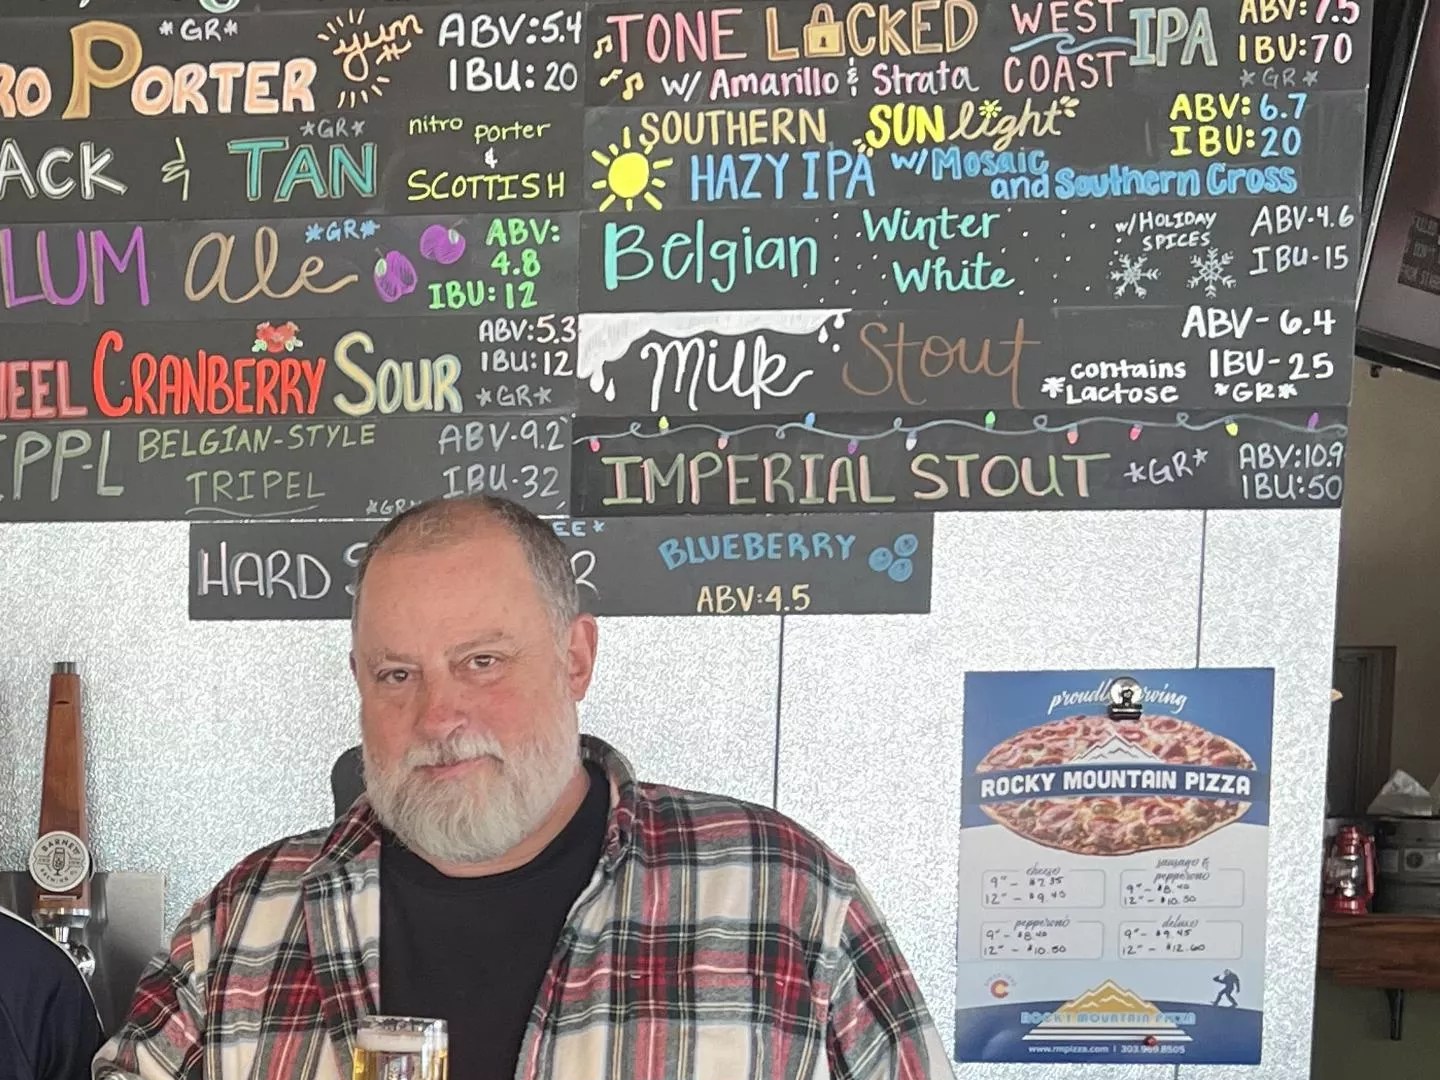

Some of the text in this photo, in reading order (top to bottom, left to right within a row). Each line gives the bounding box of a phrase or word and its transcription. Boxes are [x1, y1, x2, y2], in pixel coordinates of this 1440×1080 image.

[606, 8, 747, 63] TONE
[1127, 6, 1218, 67] IPA
[1010, 0, 1124, 34] WEST
[62, 19, 318, 121] PORTER
[709, 67, 840, 101] Amarillo
[871, 60, 980, 97] Strata
[1003, 50, 1128, 94] COAST
[408, 114, 552, 145] nitro porter
[638, 107, 828, 148] SOUTHERN
[226, 134, 379, 203] TAN
[407, 168, 566, 202] SCOTTISH
[690, 150, 790, 202] HAZY
[801, 148, 876, 200] IPA
[989, 161, 1298, 200] and Southern Cross
[485, 217, 561, 247] ABV:
[603, 206, 1001, 293] Belgian Winter
[1142, 232, 1212, 252] SPICES
[490, 248, 542, 278] 4.8
[891, 251, 1016, 293] White
[93, 329, 327, 418] CRANBERRY
[333, 330, 464, 416] SOUR
[640, 318, 1042, 413] Milk Stout
[1070, 358, 1187, 379] contains
[184, 470, 326, 503] TRIPEL
[600, 450, 1112, 505] IMPERIAL STOUT
[198, 540, 332, 600] HARD
[658, 531, 856, 571] BLUEBERRY
[980, 768, 1252, 798] ROCKY MOUNTAIN PIZZA
